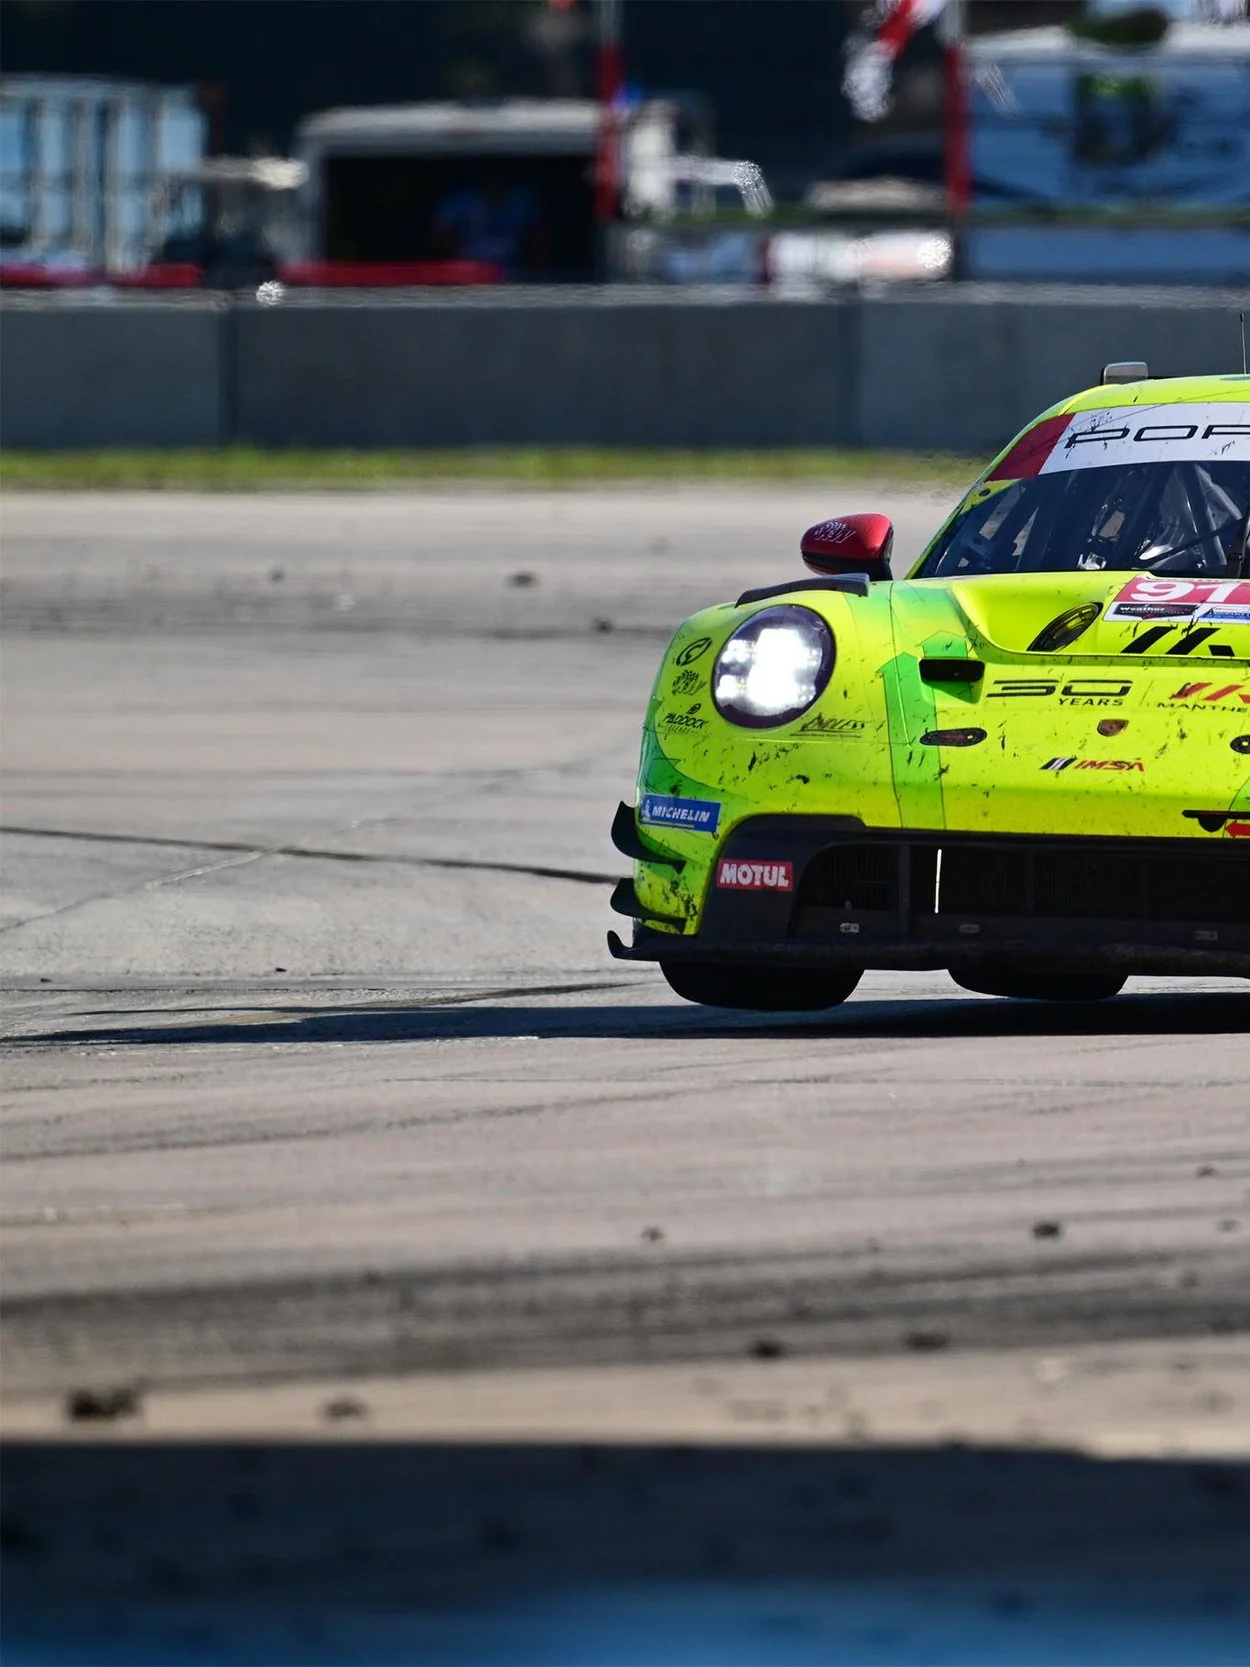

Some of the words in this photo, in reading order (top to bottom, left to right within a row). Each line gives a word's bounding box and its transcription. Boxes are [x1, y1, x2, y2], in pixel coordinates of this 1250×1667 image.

[986, 679, 1133, 697] 30
[1059, 698, 1123, 706] YEARS
[1073, 759, 1145, 772] IMSA
[651, 805, 711, 823] MICHELIN
[720, 863, 789, 887] MOTUL
